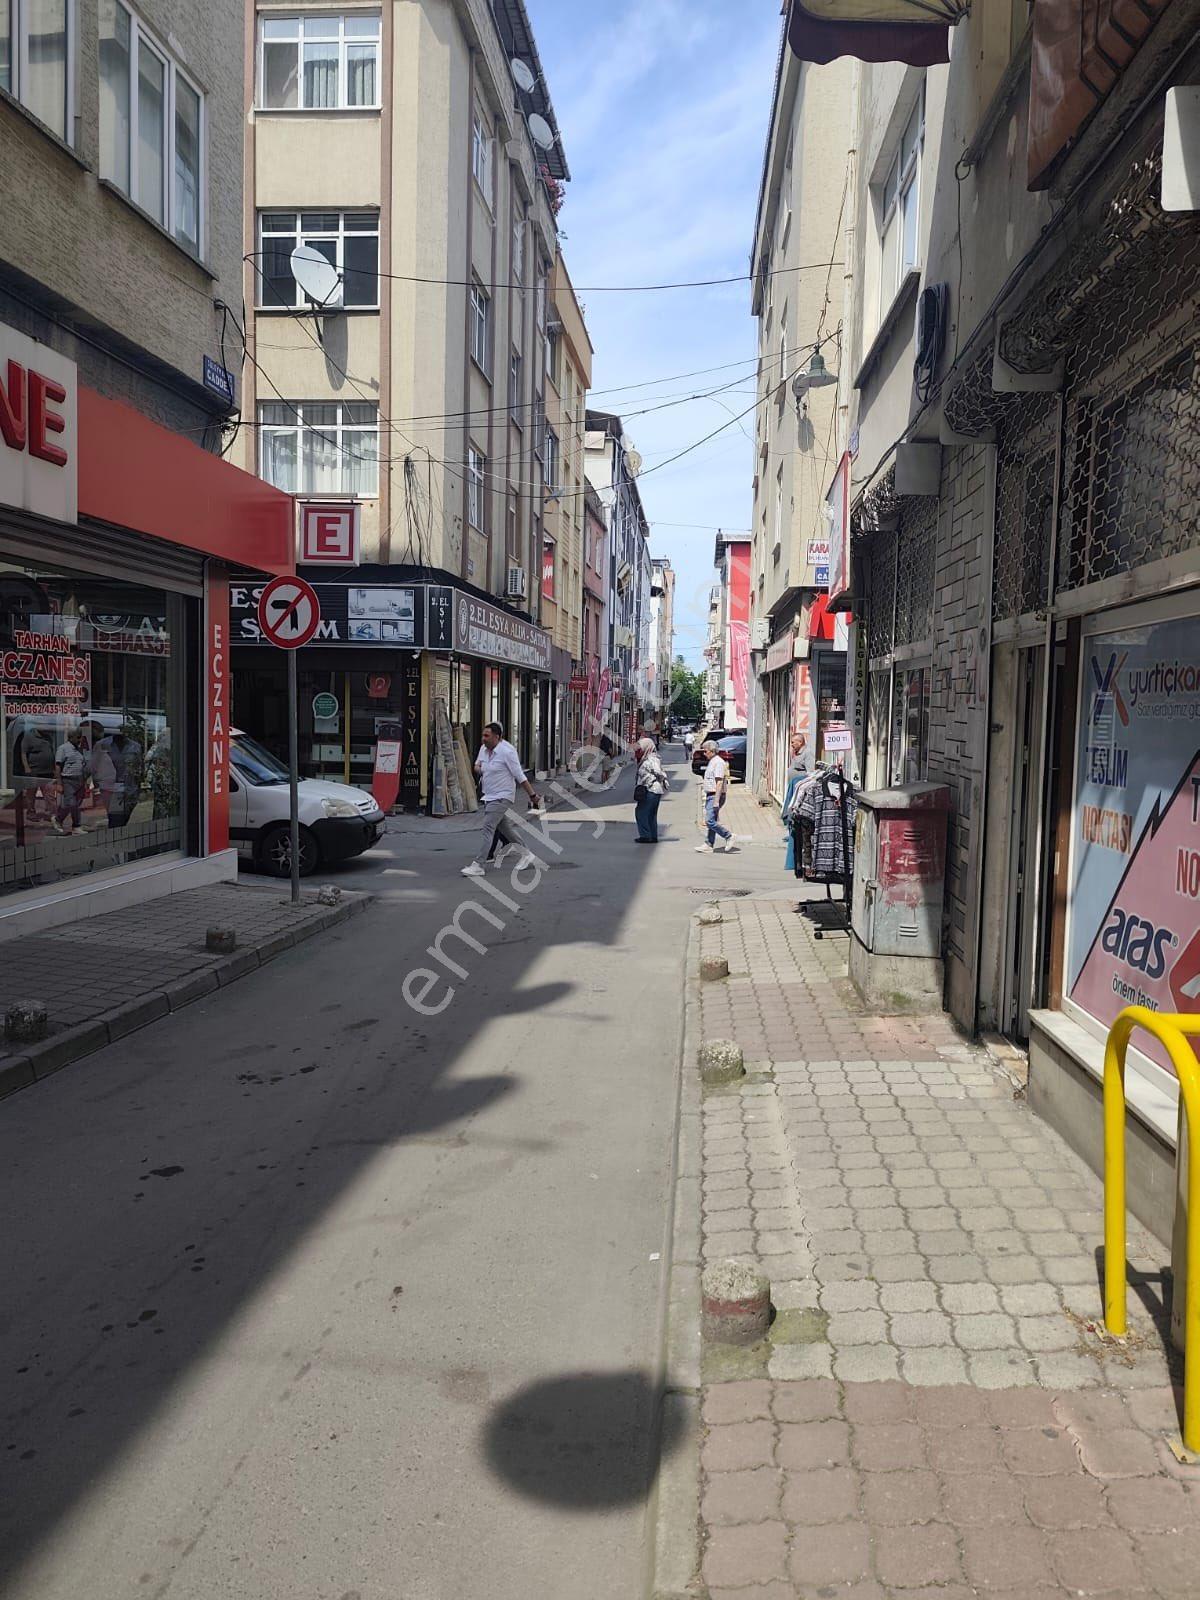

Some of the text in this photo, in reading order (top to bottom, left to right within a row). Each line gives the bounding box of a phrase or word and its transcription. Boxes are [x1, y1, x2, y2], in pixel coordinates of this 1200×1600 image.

[317, 516, 341, 552] E
[15, 629, 70, 652] TARHAN
[51, 686, 83, 698] TARHAN
[212, 624, 224, 794] ECZANE
[827, 735, 840, 743] 200
[1086, 743, 1128, 788] TESLİM
[1082, 806, 1132, 854] NOKTASI
[1102, 908, 1173, 979] aras
[1112, 974, 1136, 1004] önem
